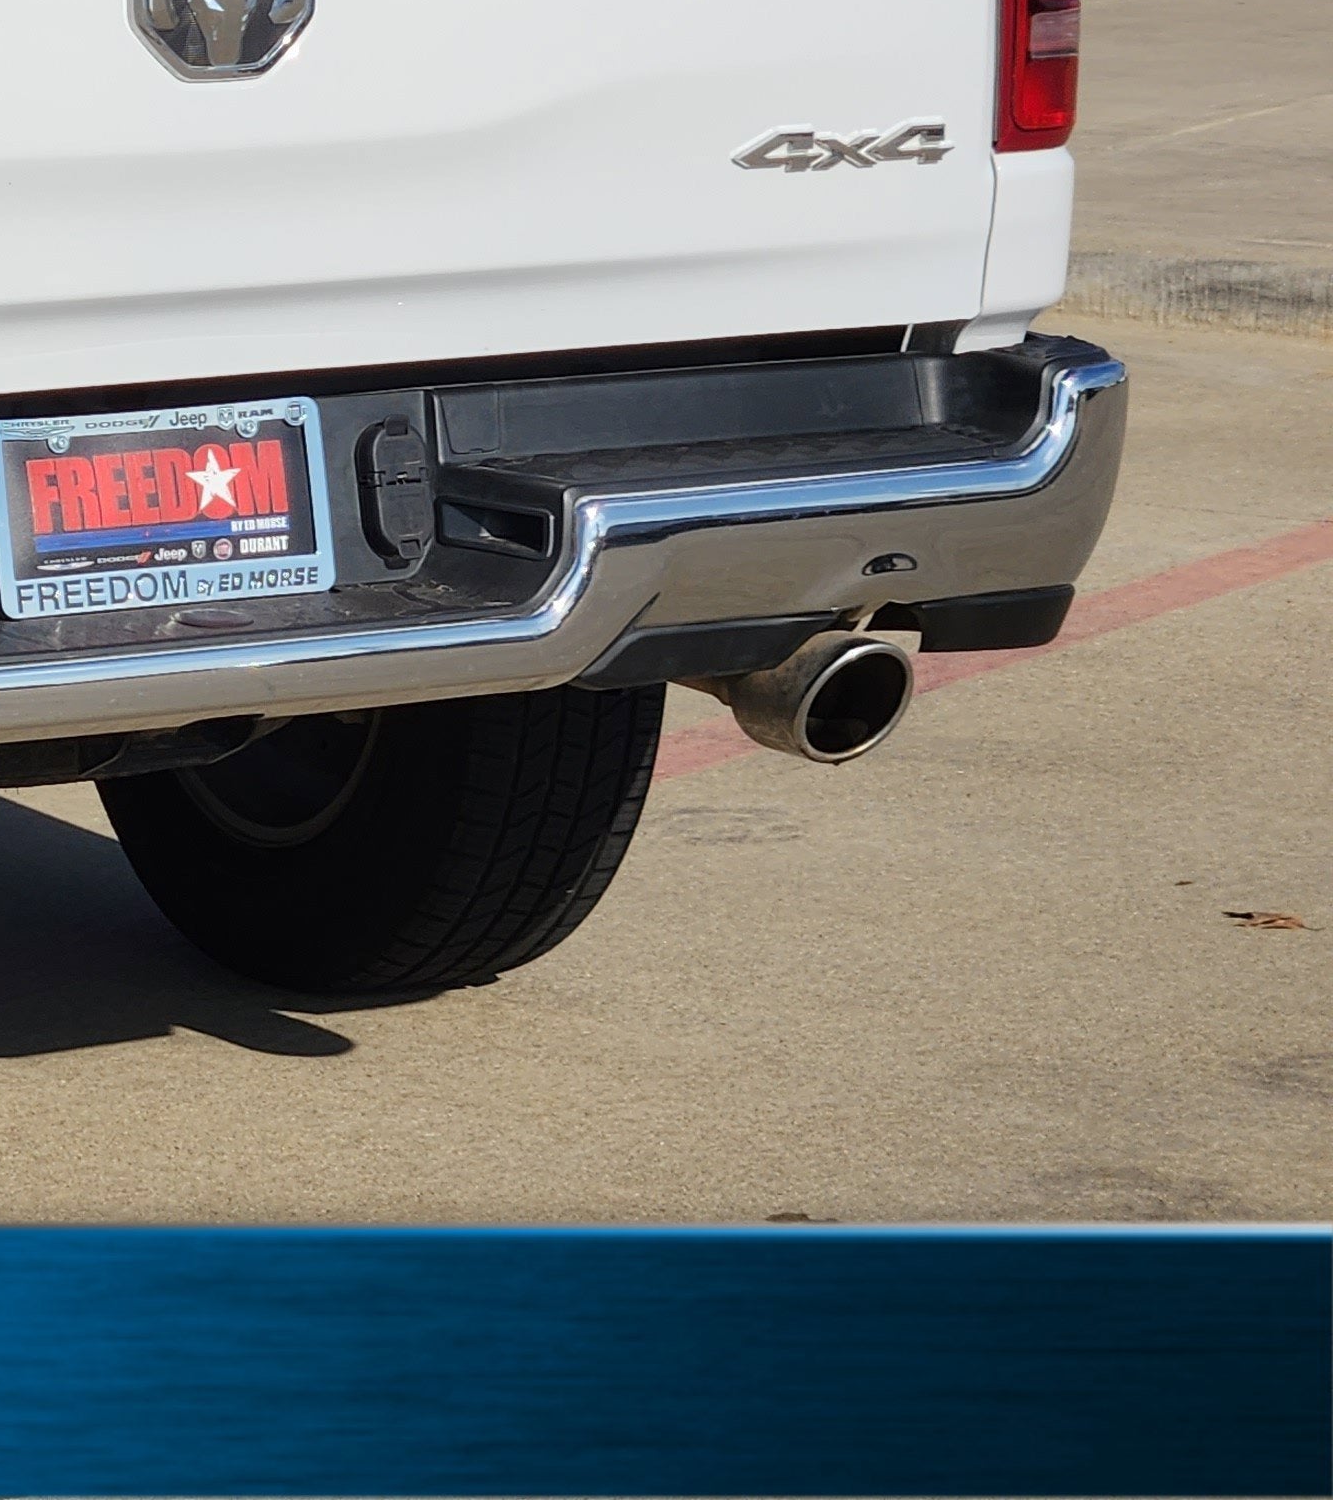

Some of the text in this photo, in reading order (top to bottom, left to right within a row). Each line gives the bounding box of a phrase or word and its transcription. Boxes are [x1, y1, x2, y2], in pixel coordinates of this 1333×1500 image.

[169, 411, 208, 427] Jeep
[237, 408, 274, 419] RAM
[154, 547, 188, 562] Jeep
[239, 535, 289, 555] DURANT
[16, 569, 189, 614] FREEDOM
[218, 572, 243, 592] ED
[248, 566, 319, 590] MORSE
